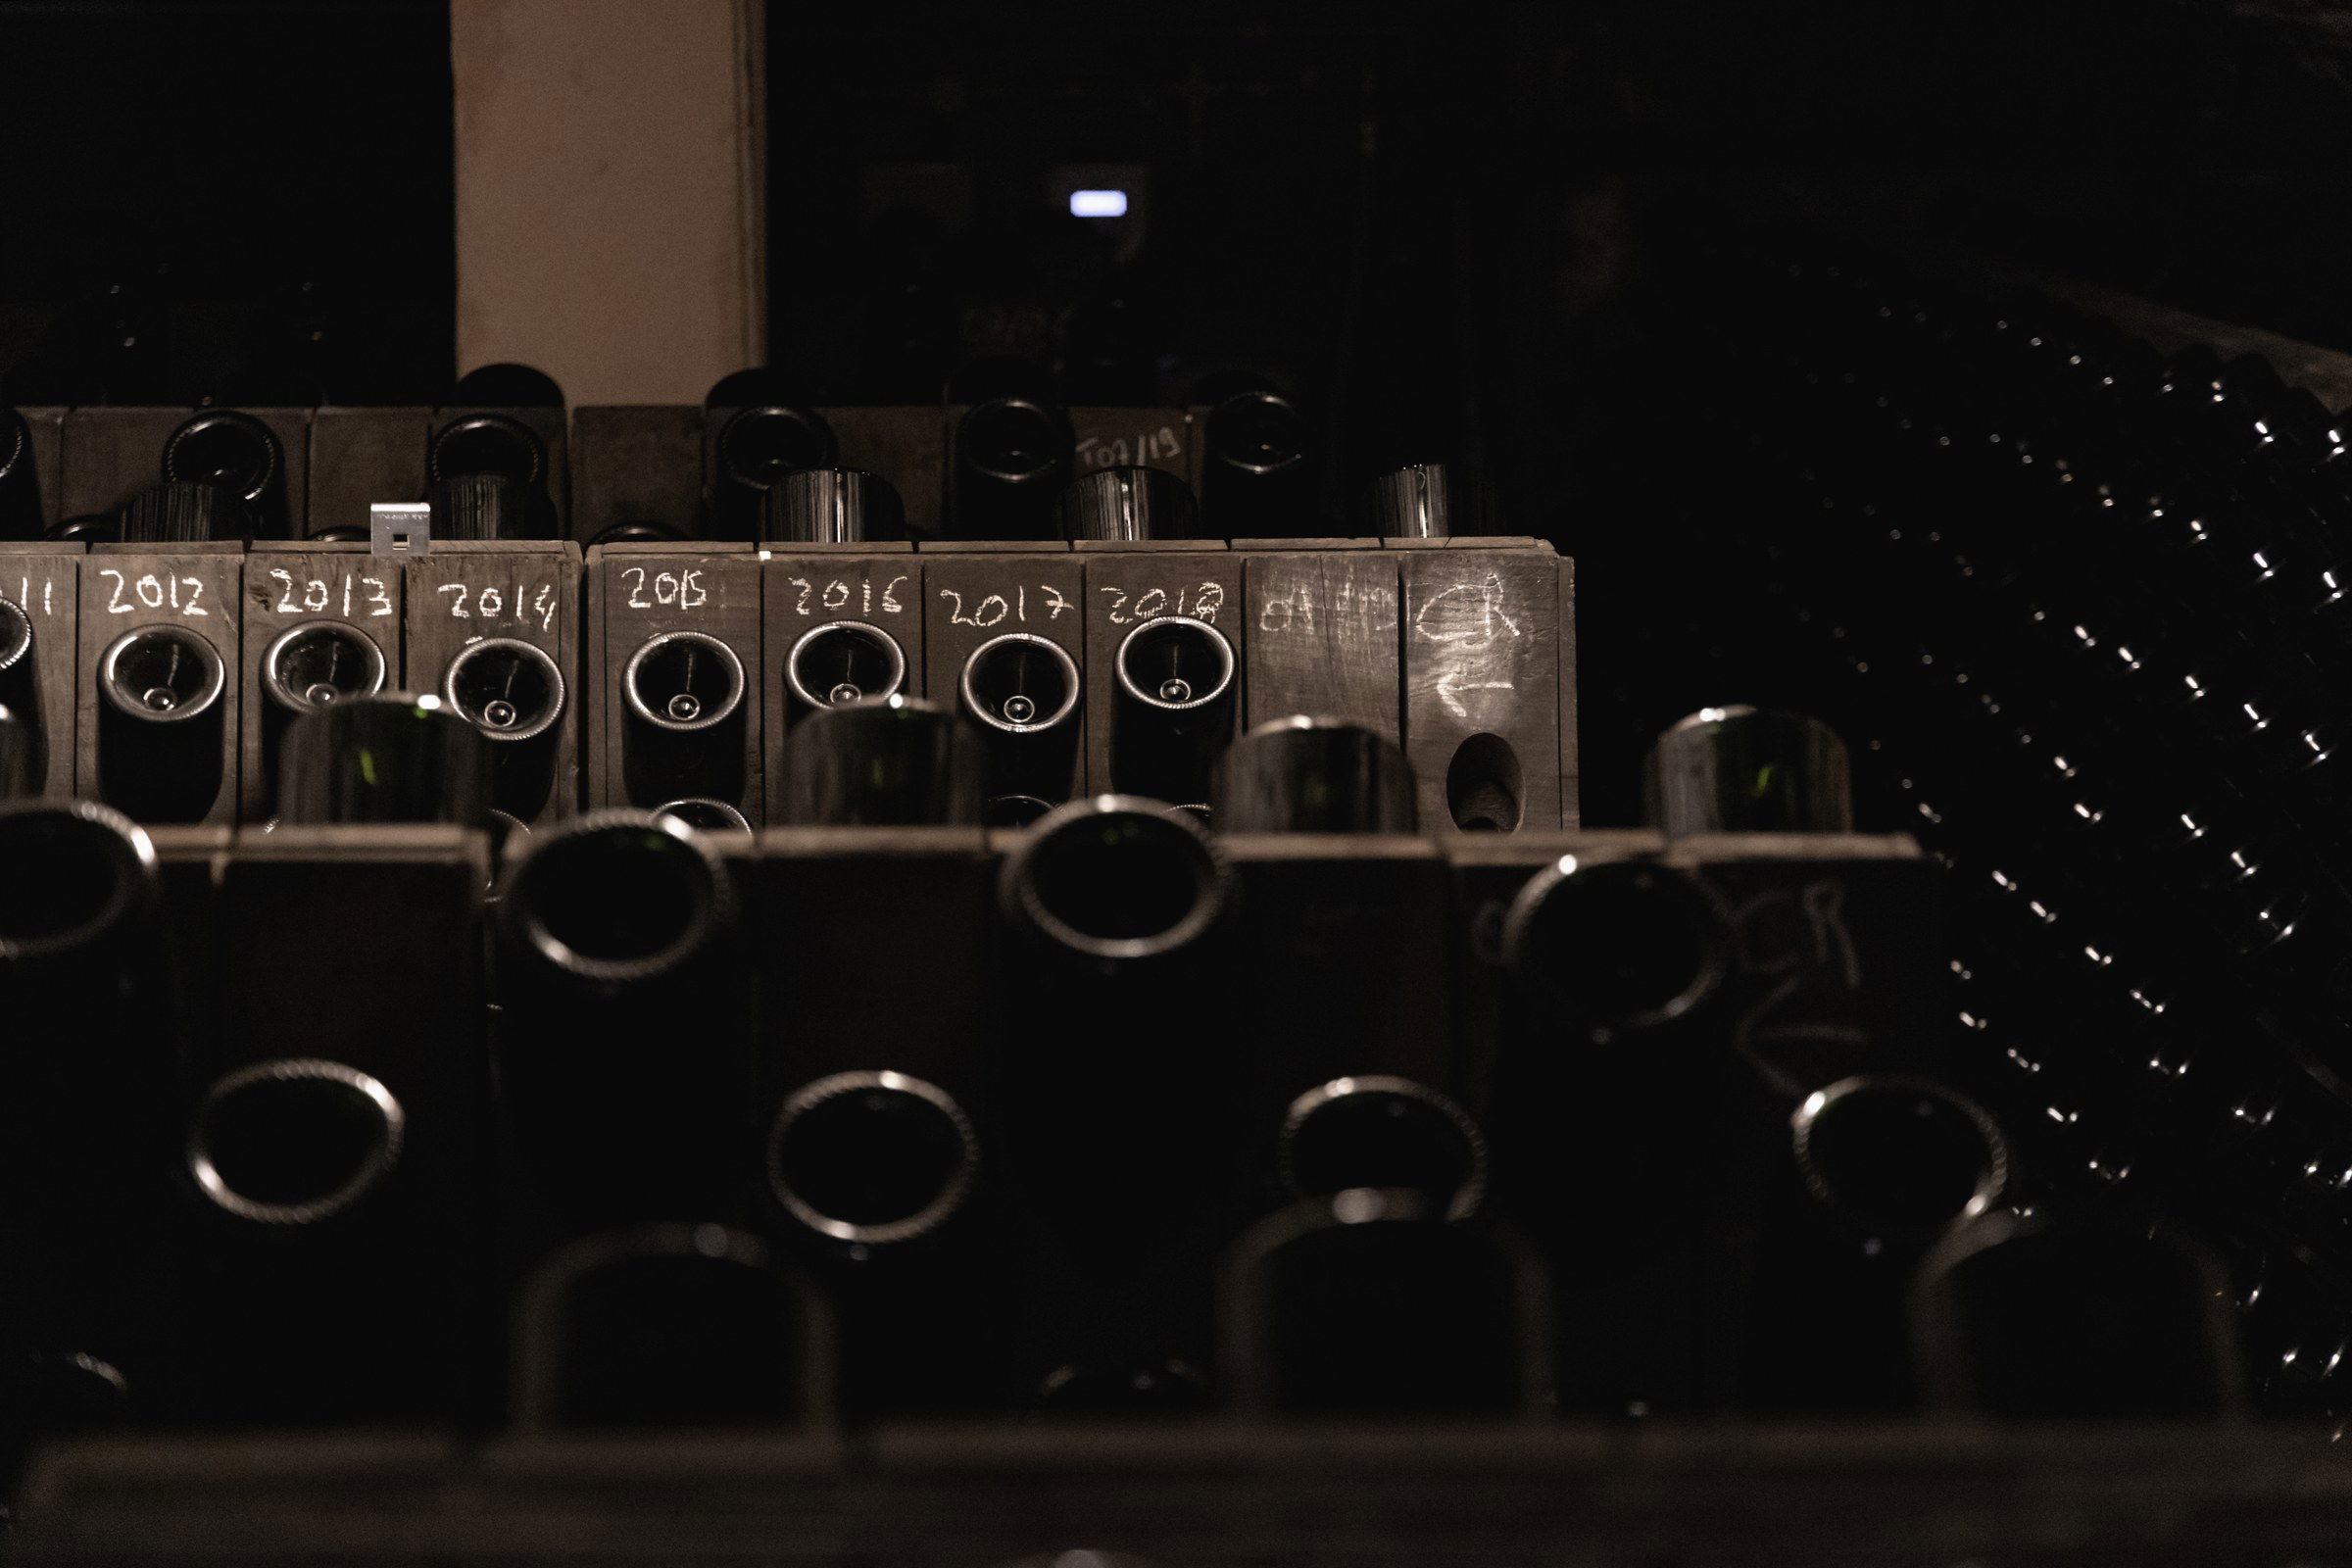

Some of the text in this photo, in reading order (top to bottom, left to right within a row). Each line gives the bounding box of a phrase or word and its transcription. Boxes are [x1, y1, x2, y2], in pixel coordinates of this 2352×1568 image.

[0, 576, 52, 615] 11
[100, 569, 208, 615] 2012
[269, 568, 392, 616] 2013
[438, 584, 557, 630] 2014
[620, 567, 707, 610] 2015
[788, 575, 908, 617] 2016
[940, 585, 1074, 626] 2017
[1101, 581, 1224, 624] 2018
